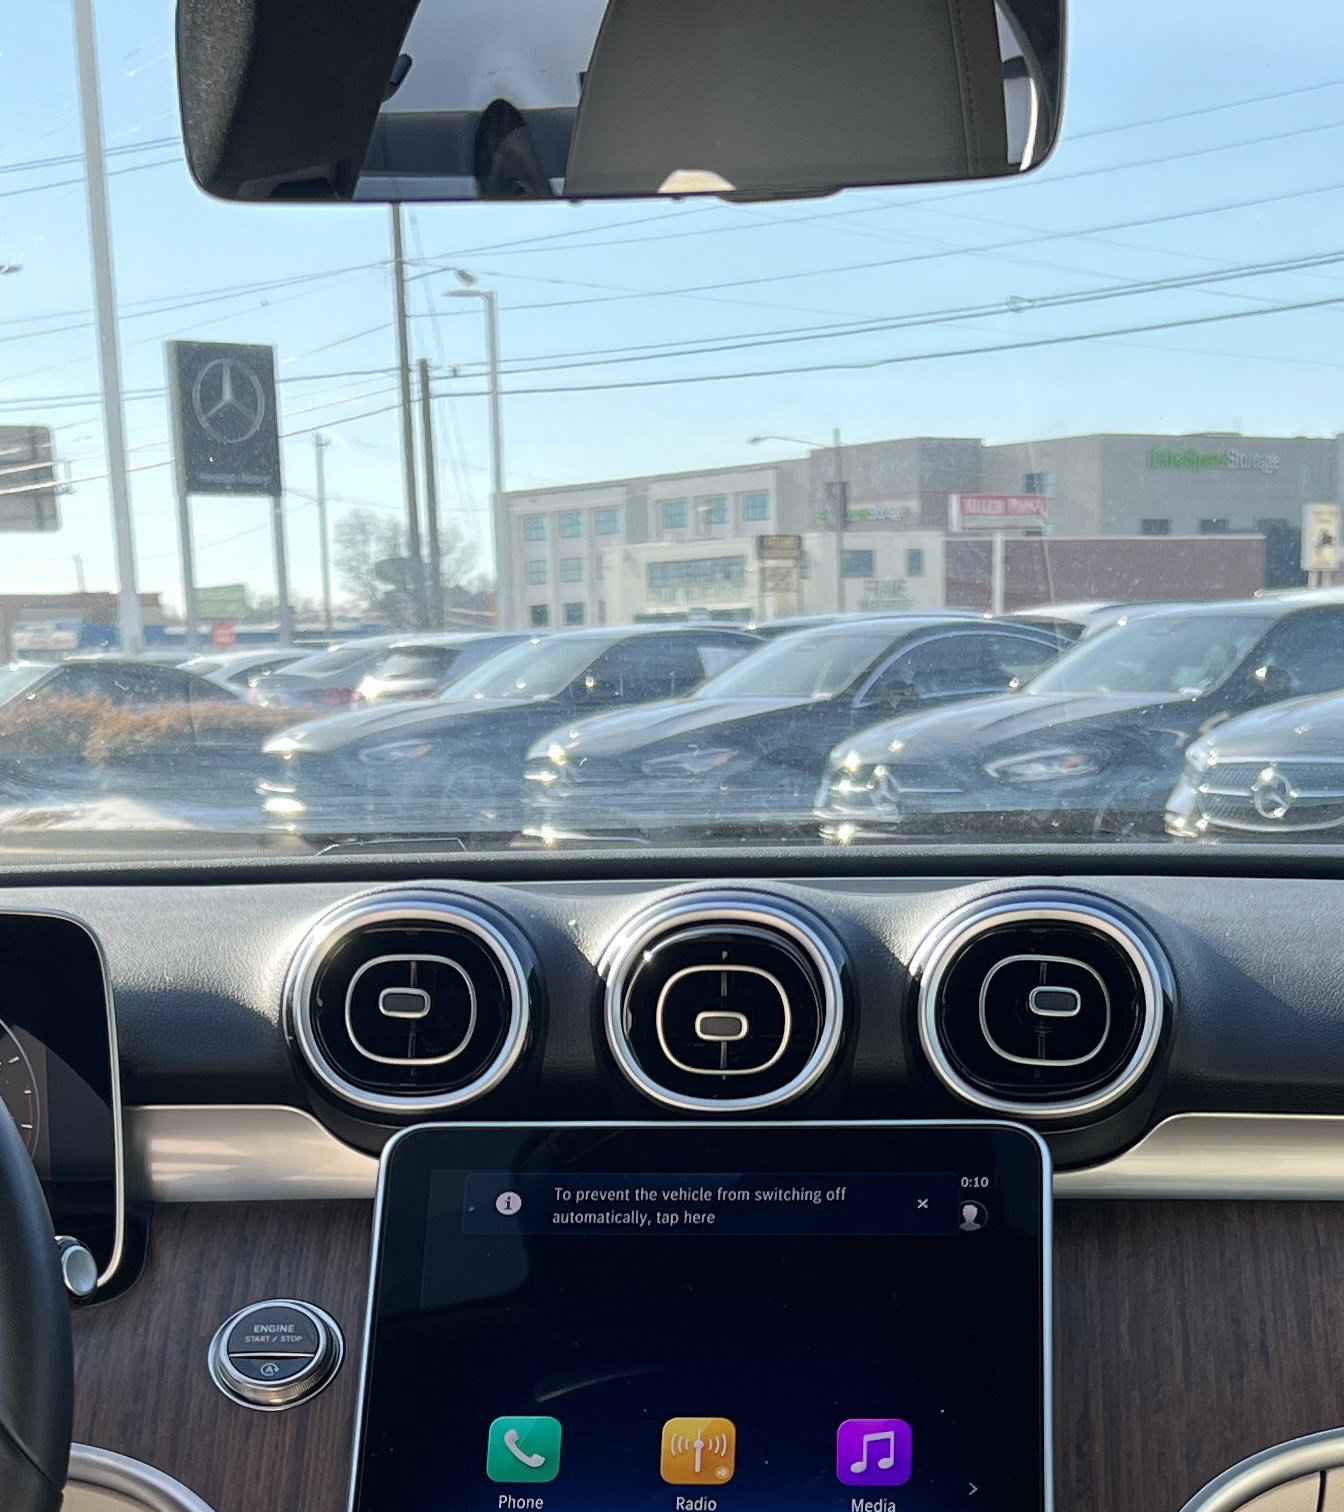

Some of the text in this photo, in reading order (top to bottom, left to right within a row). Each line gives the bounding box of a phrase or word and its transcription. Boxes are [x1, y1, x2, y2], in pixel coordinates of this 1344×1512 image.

[960, 1176, 988, 1188] 0:10
[555, 1187, 847, 1206] To prevent the vehicle from switching off
[552, 1209, 716, 1227] automatically, tap here
[254, 1324, 294, 1333] ENGINE
[245, 1335, 270, 1343] START
[280, 1335, 303, 1343] STOP
[498, 1494, 544, 1511] Phone
[676, 1496, 717, 1512] Radio
